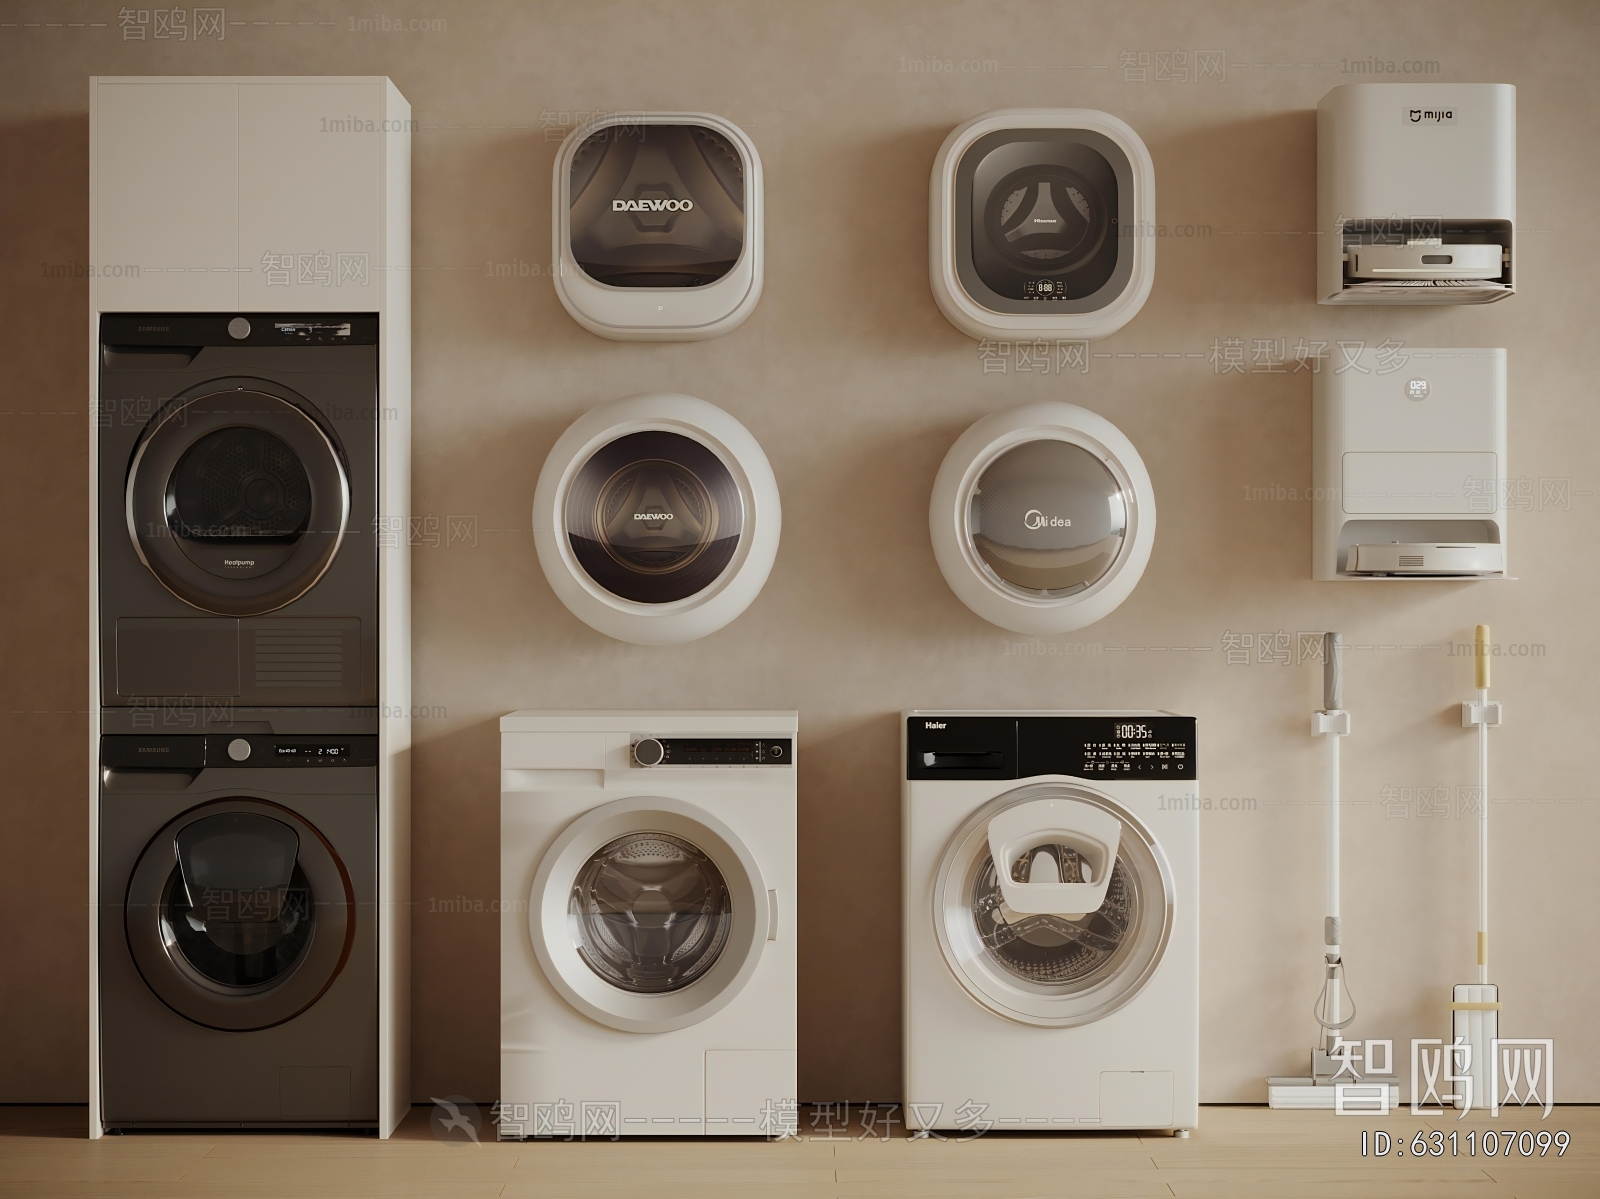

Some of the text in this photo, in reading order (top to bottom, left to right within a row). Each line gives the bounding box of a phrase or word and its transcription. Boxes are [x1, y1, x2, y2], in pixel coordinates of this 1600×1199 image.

[1424, 111, 1453, 123] mijia
[612, 199, 694, 212] DAEWOO
[925, 721, 947, 730] Haier
[1121, 724, 1148, 739] 00:35
